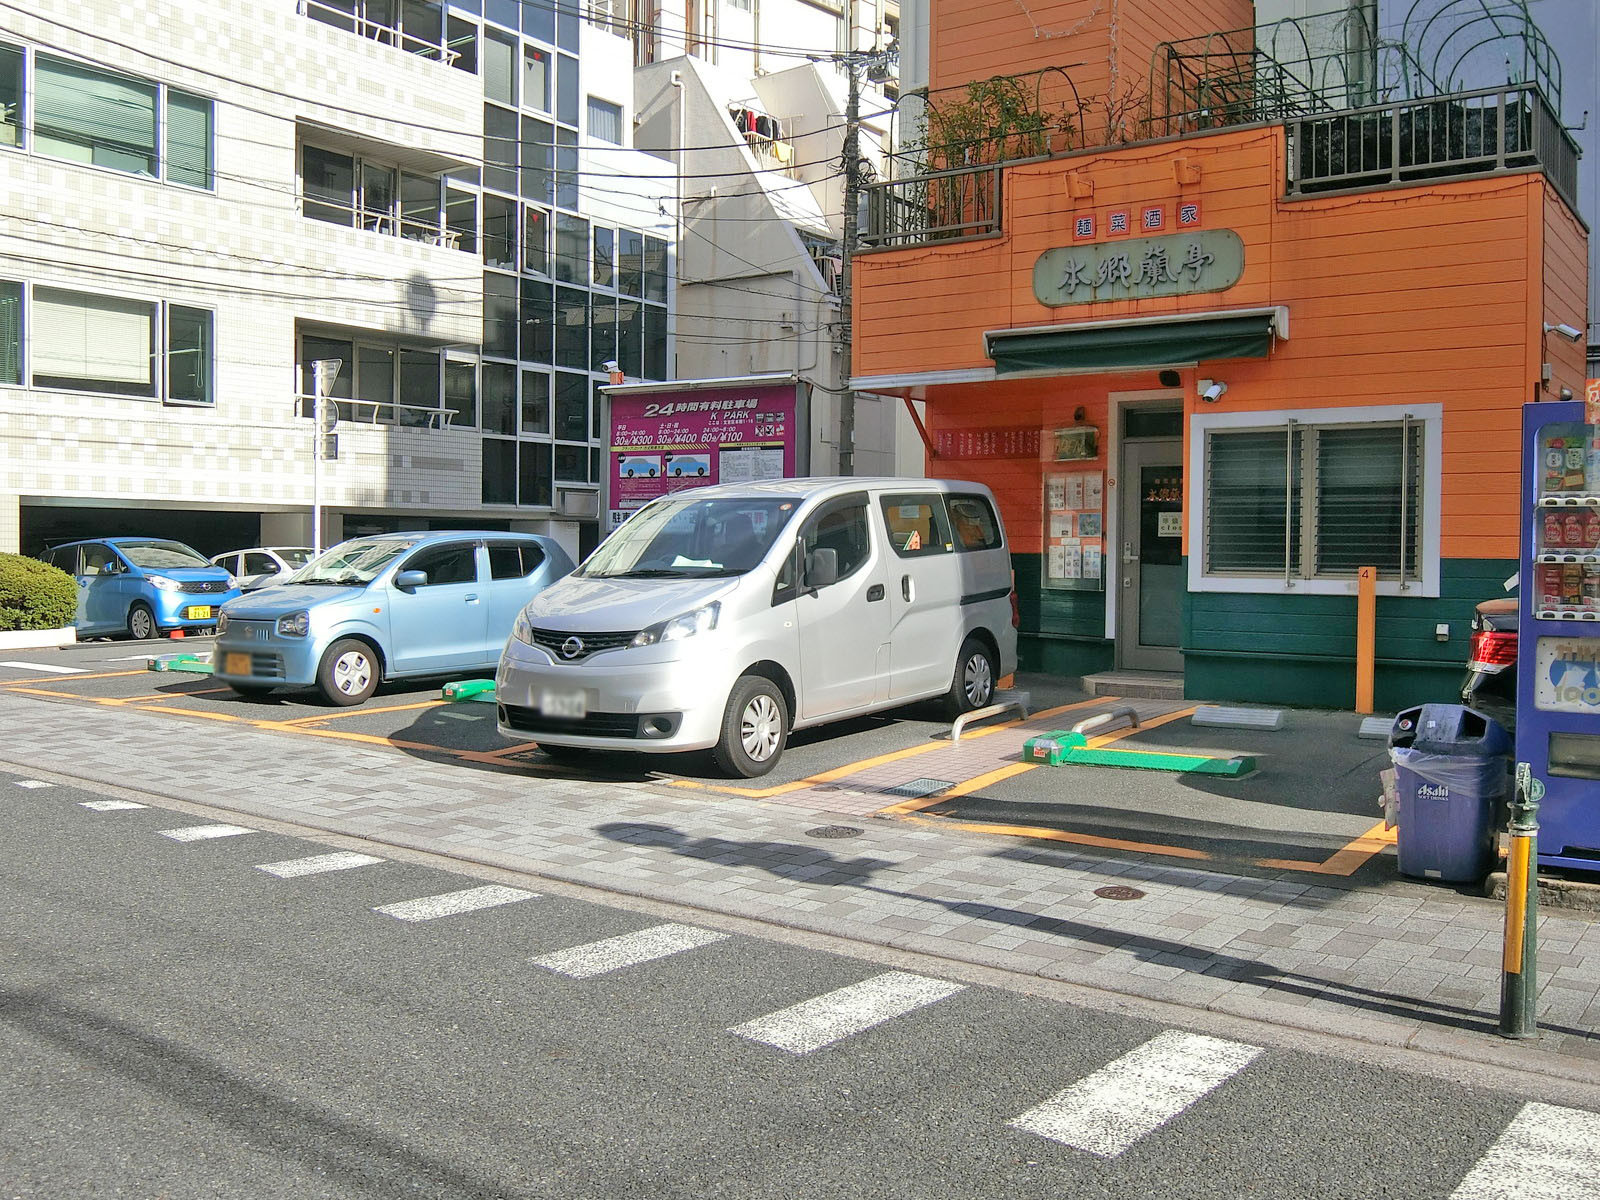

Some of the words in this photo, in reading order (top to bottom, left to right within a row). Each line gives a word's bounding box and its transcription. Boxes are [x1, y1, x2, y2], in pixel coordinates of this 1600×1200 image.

[1076, 205, 1198, 237] 麺菜酒家
[643, 399, 758, 418] 24時間有料駐車場
[710, 412, 718, 420] K
[723, 410, 750, 419] PARK
[1361, 569, 1369, 579] 4
[1417, 784, 1449, 797] Asahi
